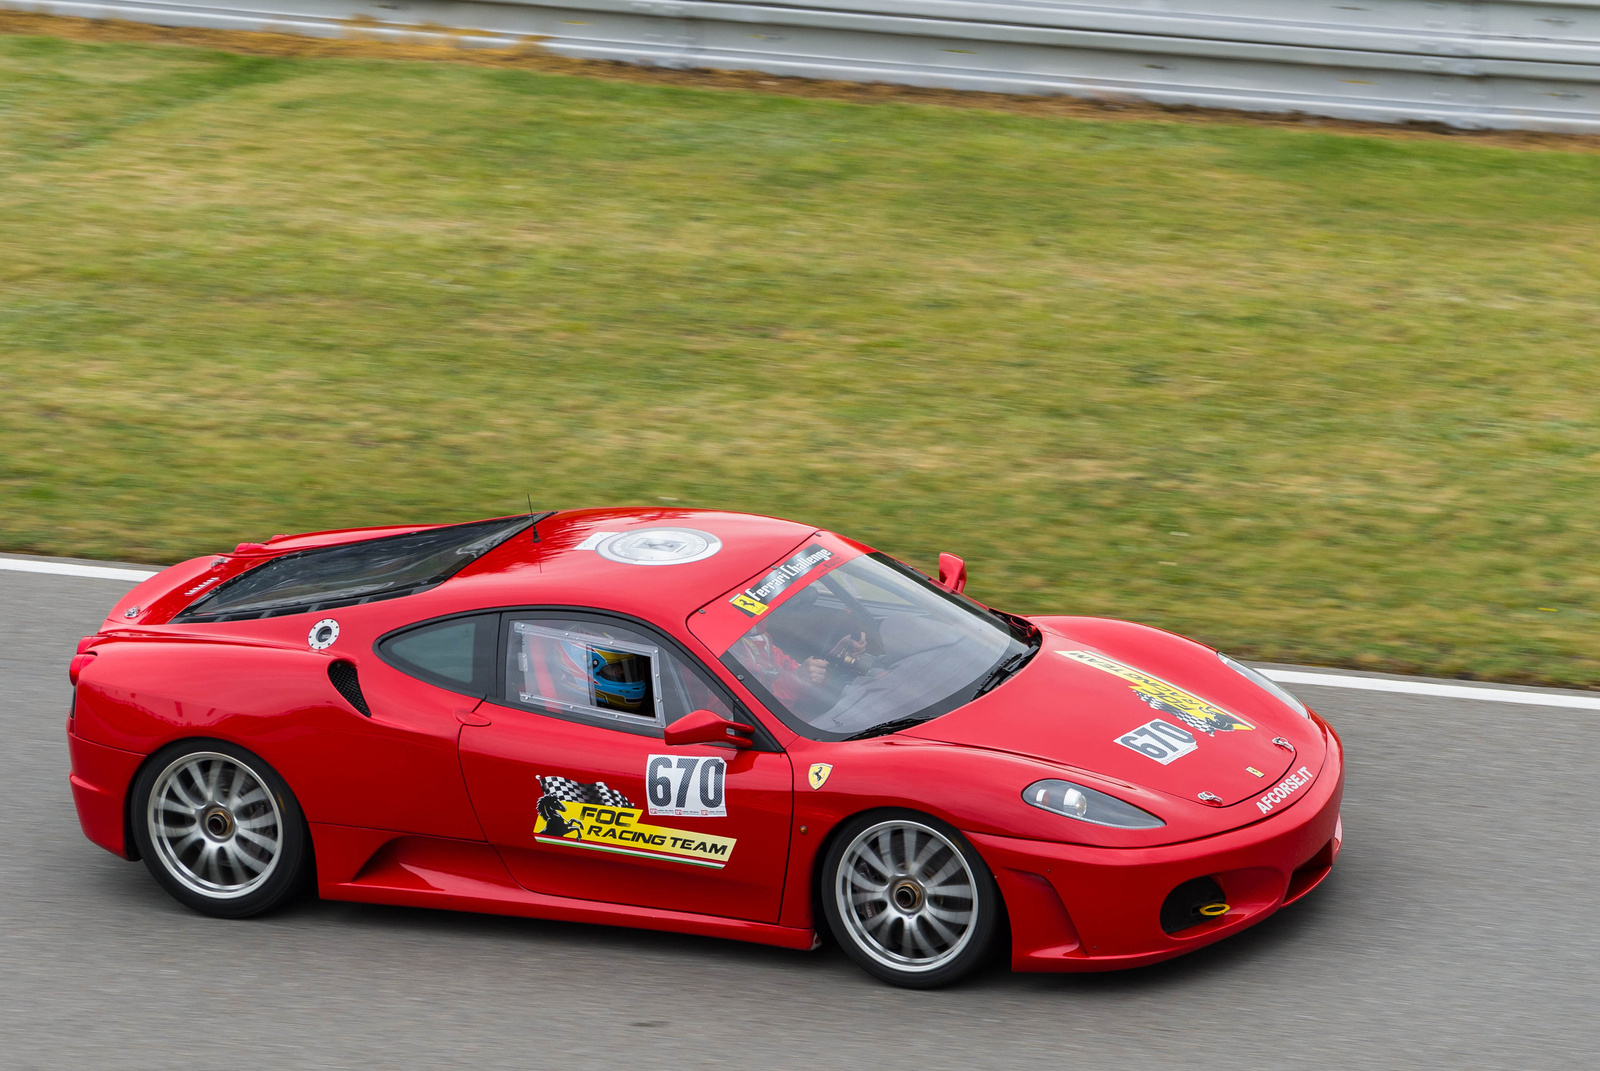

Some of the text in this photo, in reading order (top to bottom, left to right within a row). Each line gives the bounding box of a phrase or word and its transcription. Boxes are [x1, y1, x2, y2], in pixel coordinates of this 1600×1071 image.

[745, 571, 791, 601] Ferrari
[779, 549, 831, 577] Challenge
[1068, 651, 1200, 705] RACING TEAM
[1140, 687, 1196, 711] FOC
[1120, 721, 1196, 759] 670
[649, 757, 724, 808] 670
[1256, 766, 1313, 814] AFCORSE.IT
[580, 806, 635, 827] FOC
[586, 825, 728, 855] RACING TEAM
